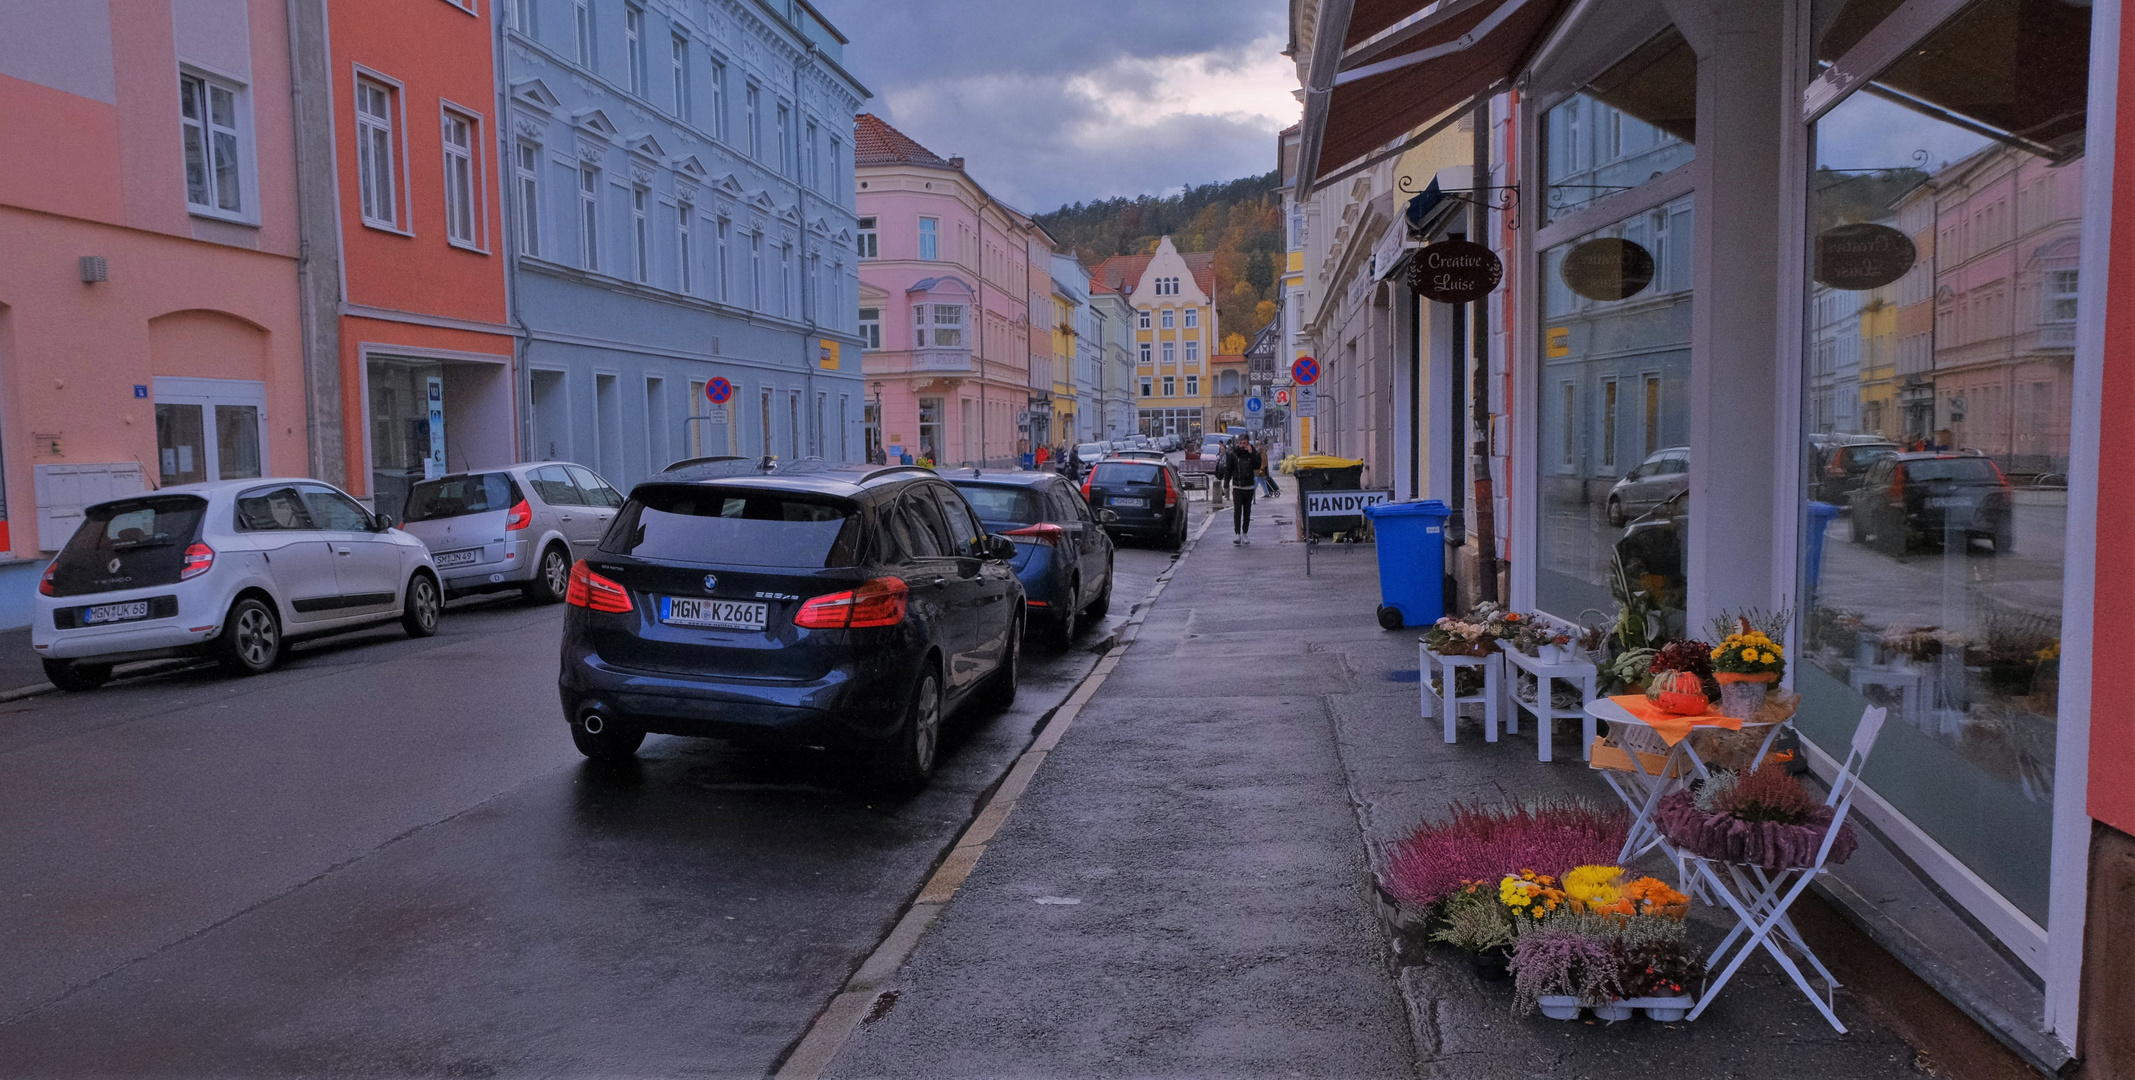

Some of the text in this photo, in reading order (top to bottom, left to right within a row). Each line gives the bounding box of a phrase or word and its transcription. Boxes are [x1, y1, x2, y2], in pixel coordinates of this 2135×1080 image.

[1428, 252, 1482, 268] Creative
[1434, 274, 1475, 292] Luise
[1309, 496, 1364, 512] HANDY
[462, 552, 471, 560] 49
[93, 576, 132, 585] TWINGO
[90, 603, 146, 619] MGN UK 68
[671, 600, 701, 619] MGN
[712, 603, 722, 621] K
[725, 604, 765, 623] 266E
